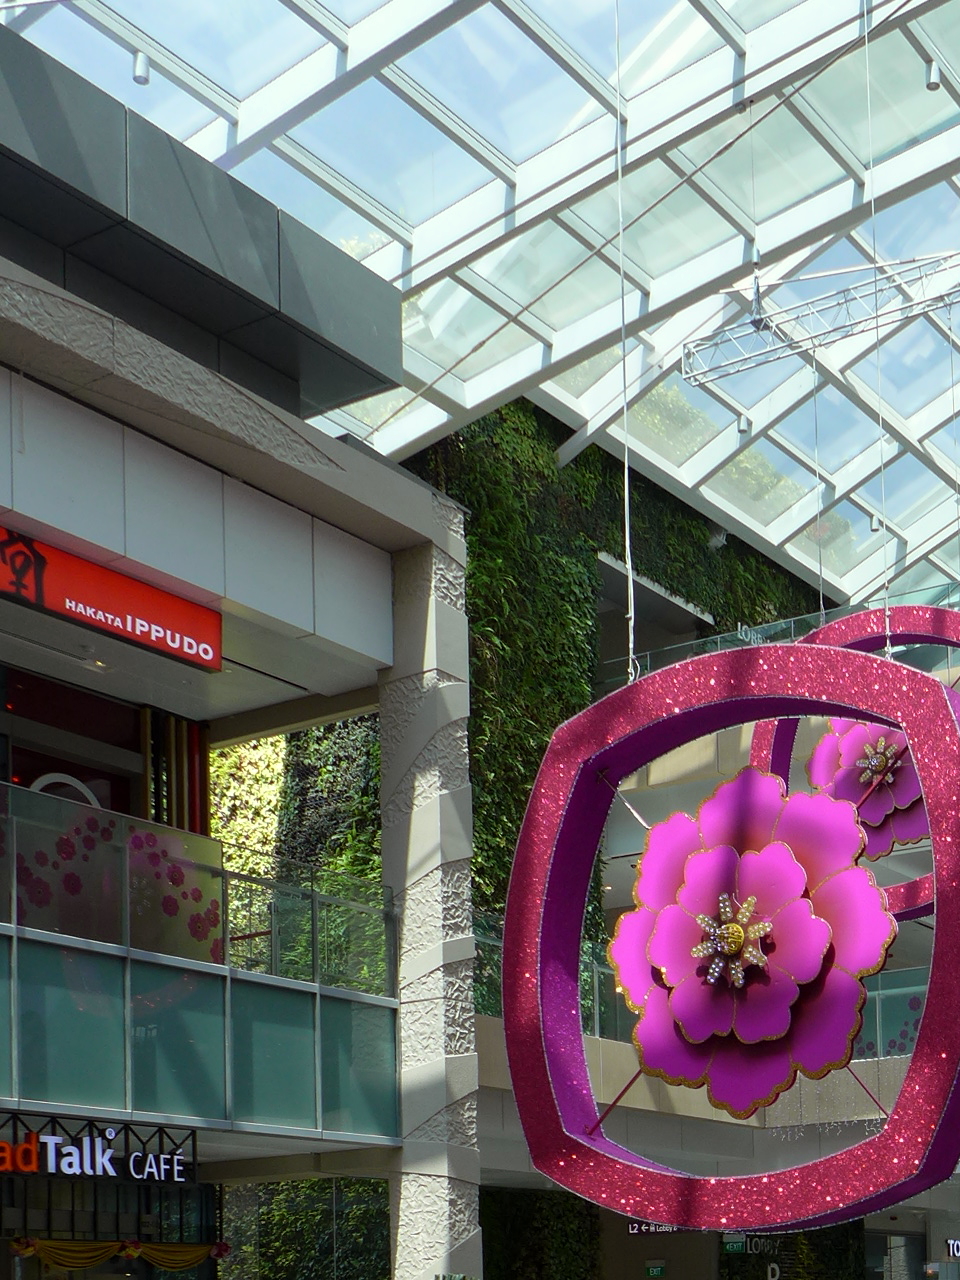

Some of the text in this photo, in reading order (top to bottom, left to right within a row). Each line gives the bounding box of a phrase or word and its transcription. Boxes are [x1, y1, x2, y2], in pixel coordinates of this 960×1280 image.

[65, 598, 214, 661] HAKATA IPPUDO
[129, 1148, 186, 1182] CAFÉ
[629, 1223, 639, 1234] L2
[656, 1225, 673, 1233] Lobby
[730, 1242, 743, 1250] EXIT
[649, 1266, 662, 1276] EXIT
